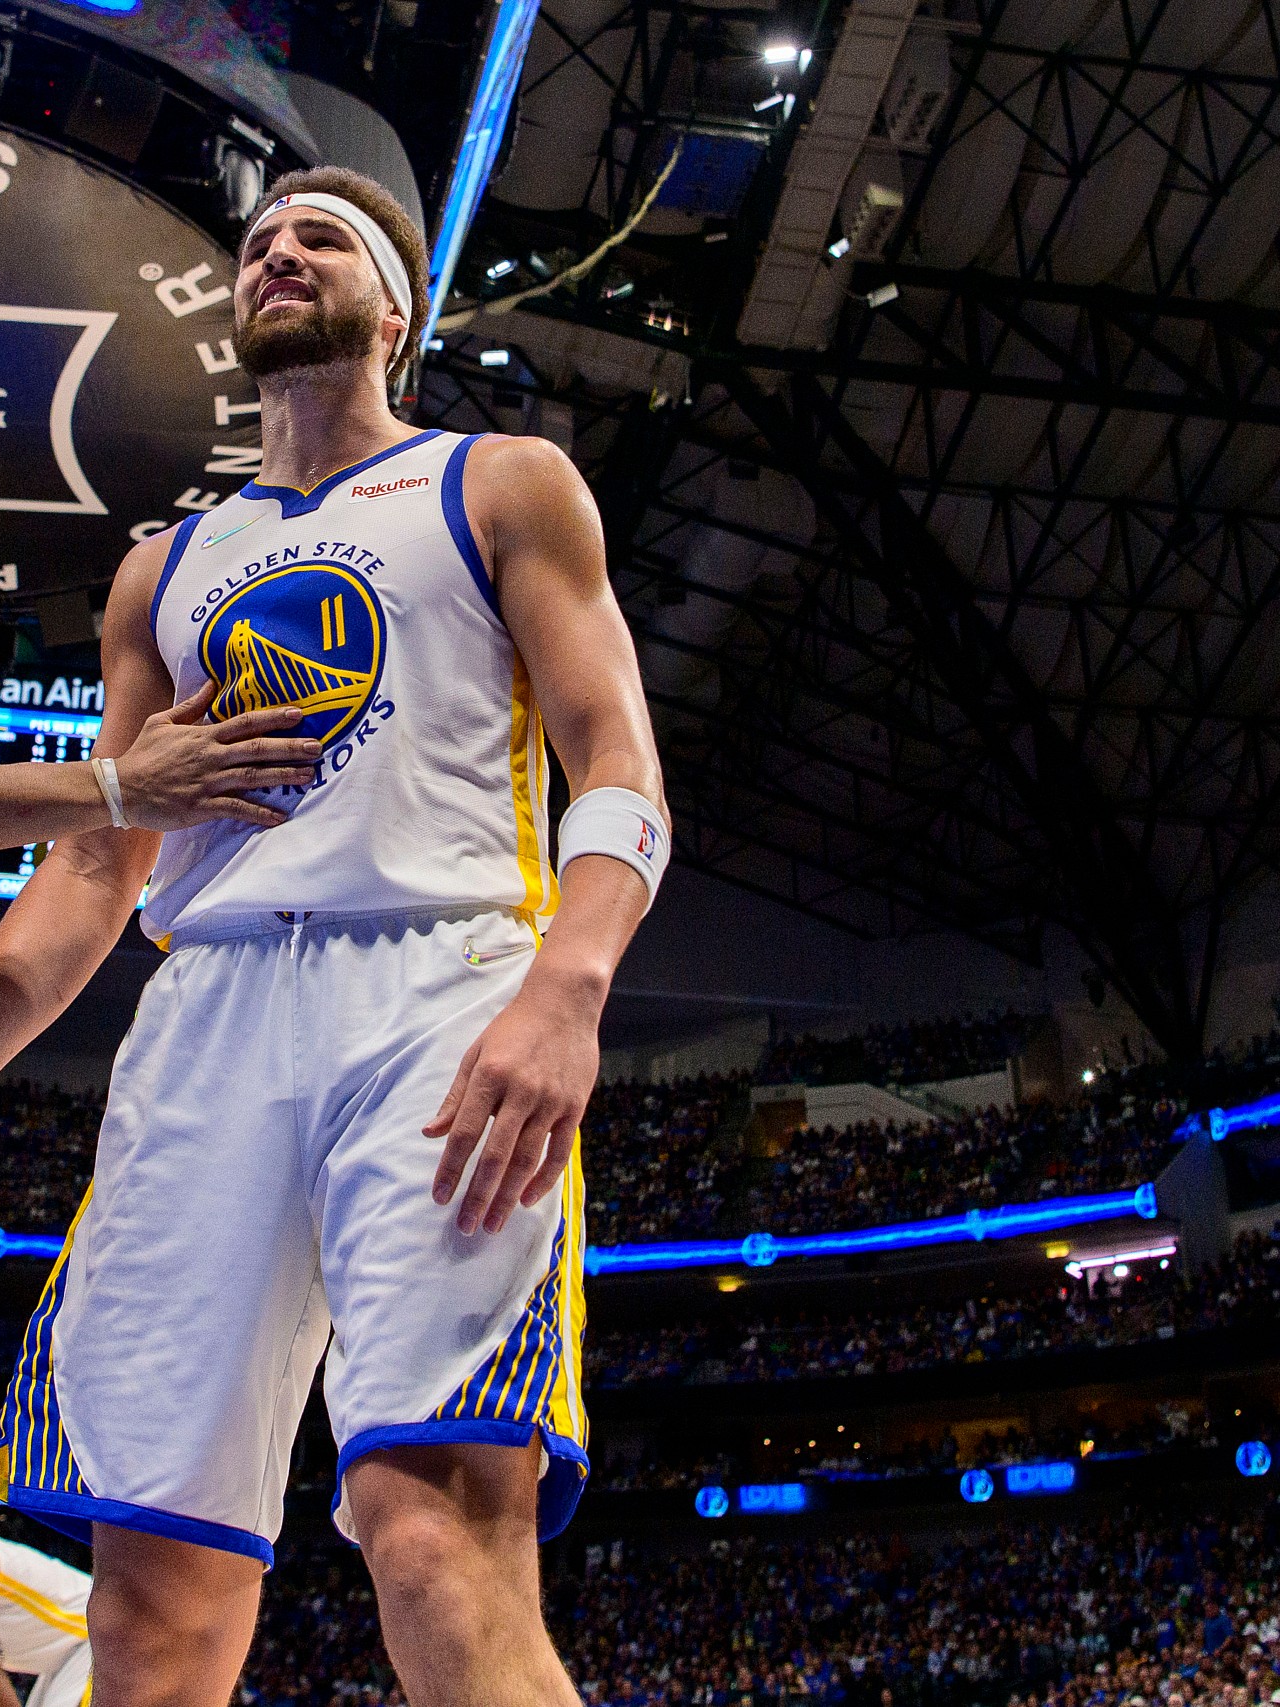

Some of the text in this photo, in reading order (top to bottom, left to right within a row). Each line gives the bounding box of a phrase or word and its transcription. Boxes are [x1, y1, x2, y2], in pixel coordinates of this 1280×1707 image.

[351, 475, 429, 498] Rakuten
[190, 541, 385, 623] GOLDEN STATE
[320, 593, 346, 651] 11
